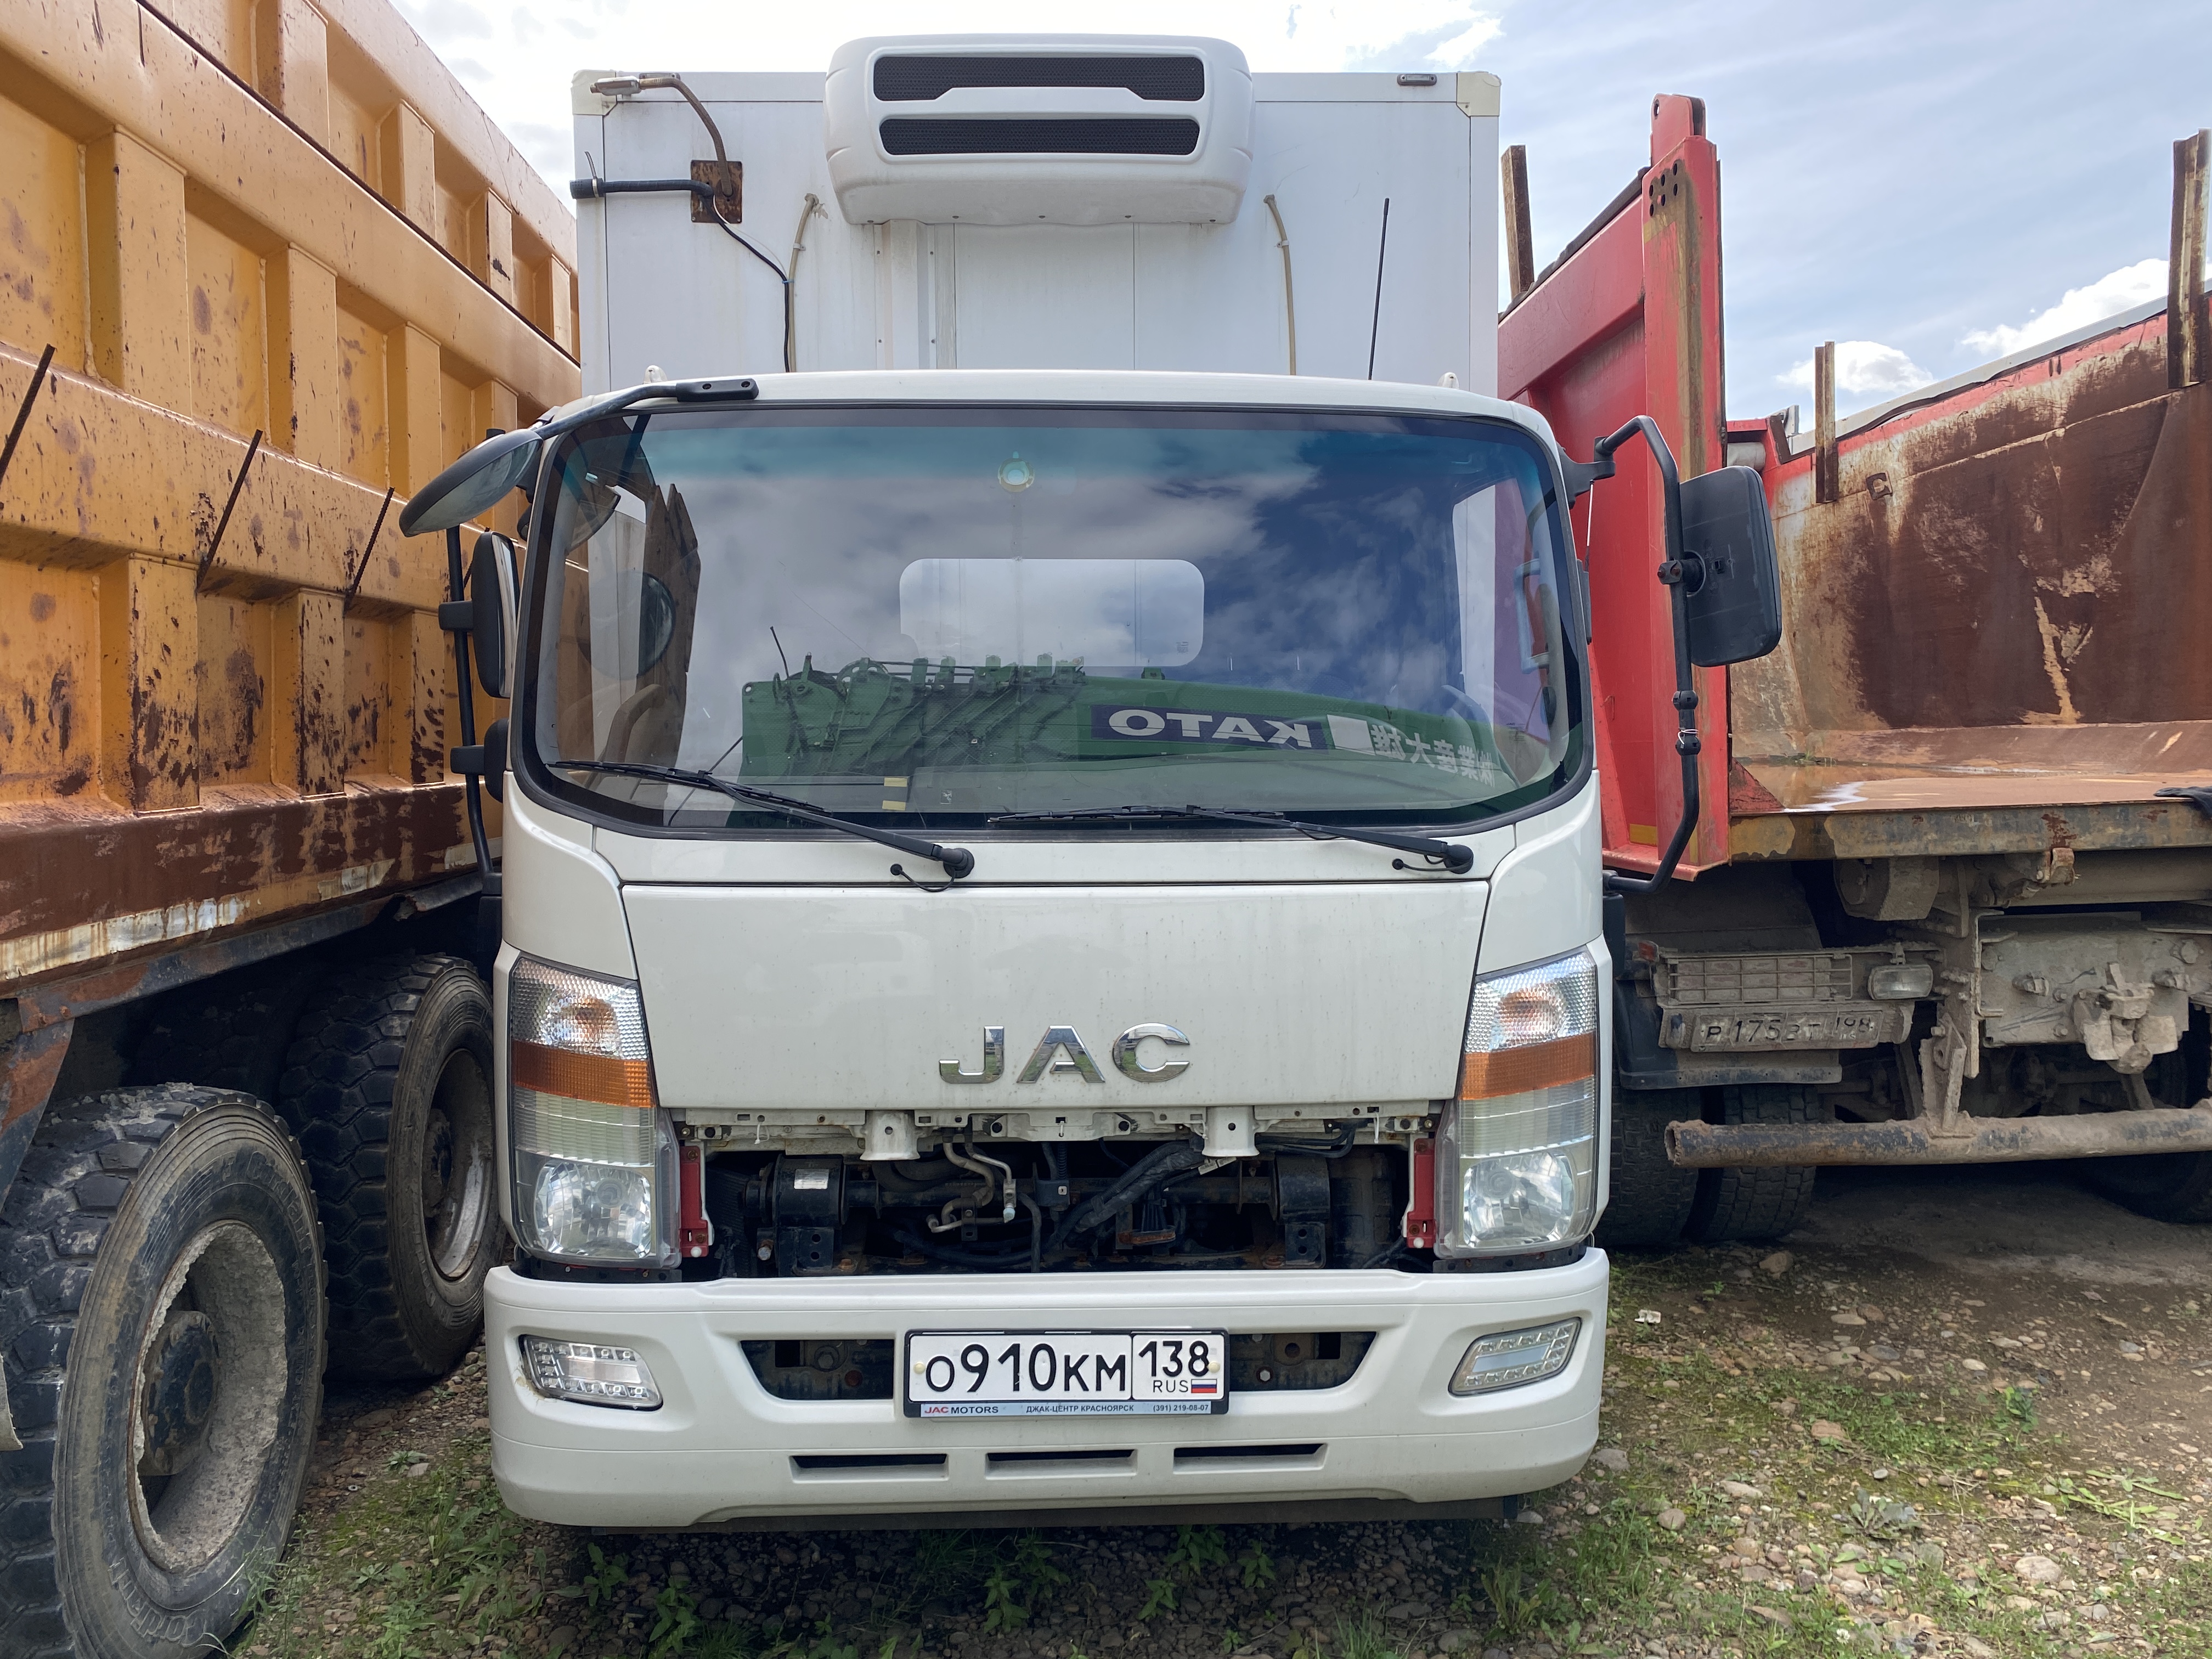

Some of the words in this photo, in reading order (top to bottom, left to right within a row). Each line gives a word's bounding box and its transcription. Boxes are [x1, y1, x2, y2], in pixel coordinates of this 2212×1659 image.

[939, 1023, 1190, 1084] JAC
[926, 1343, 1126, 1392] О910КМ
[1138, 1340, 1209, 1378] 138
[1153, 1380, 1188, 1393] RUS
[1026, 1405, 1079, 1413] ДЖАК-ЦЕНТР
